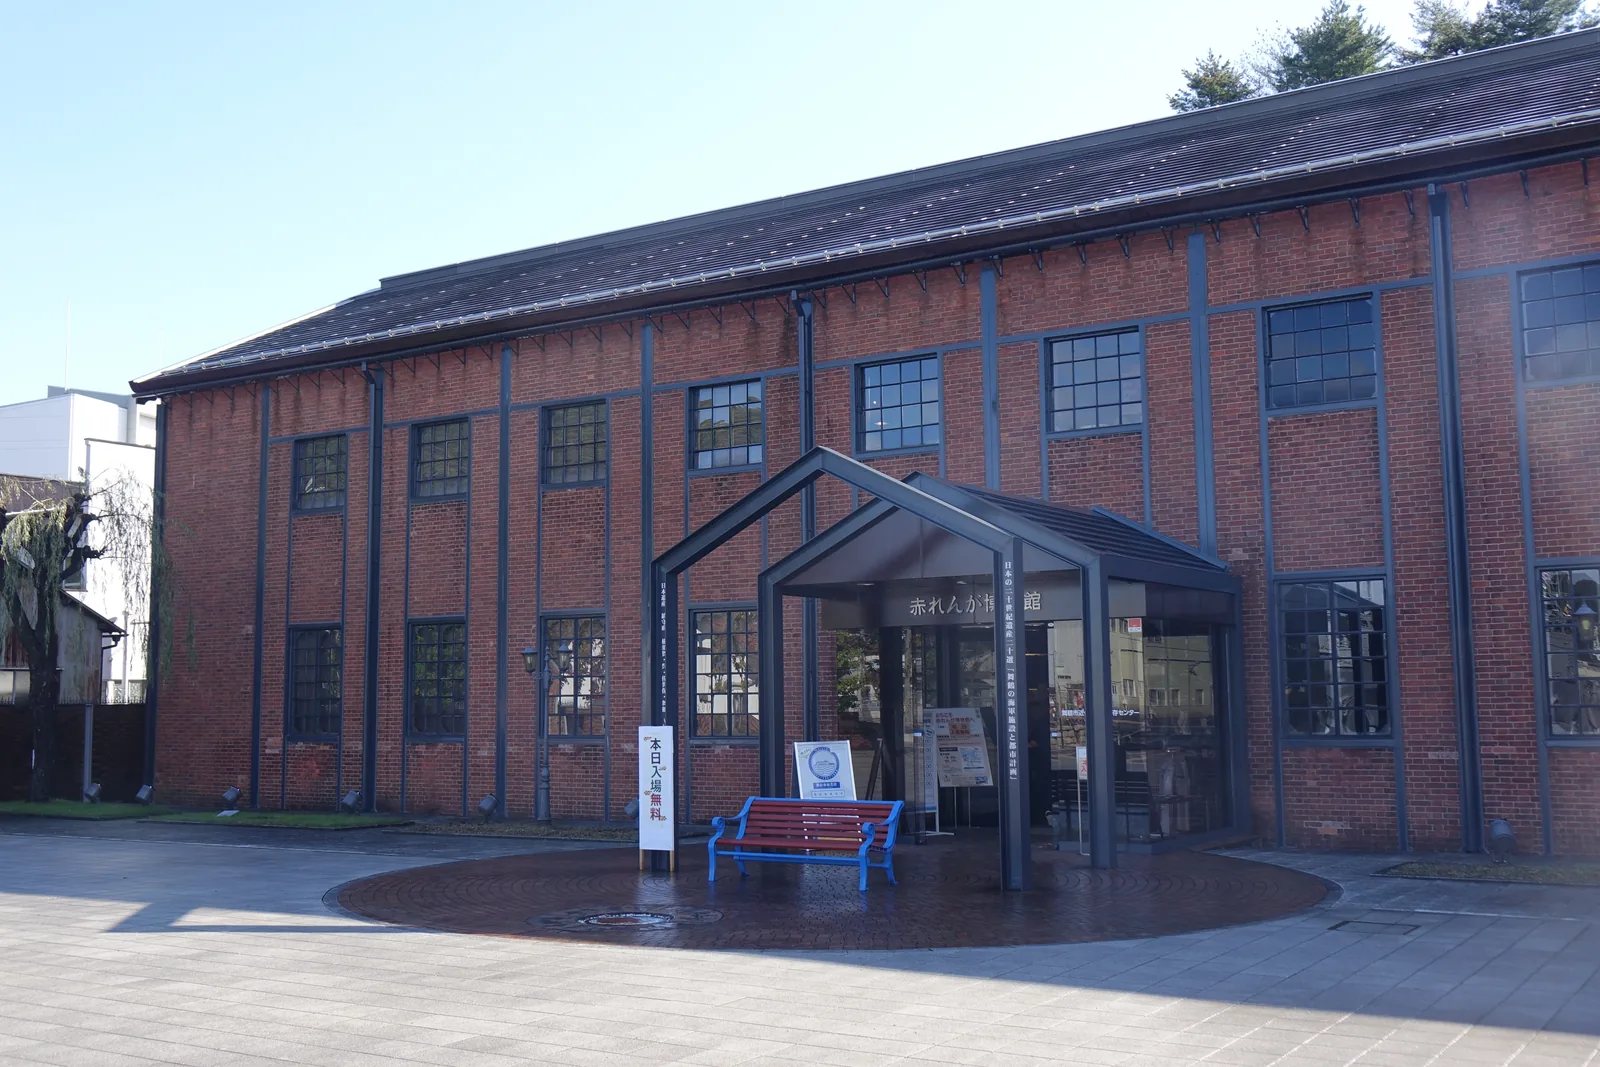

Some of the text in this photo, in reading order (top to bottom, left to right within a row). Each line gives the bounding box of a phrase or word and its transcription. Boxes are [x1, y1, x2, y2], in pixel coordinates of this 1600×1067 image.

[909, 591, 1042, 616] 赤れんが博館
[650, 737, 662, 821] 本日入場無料
